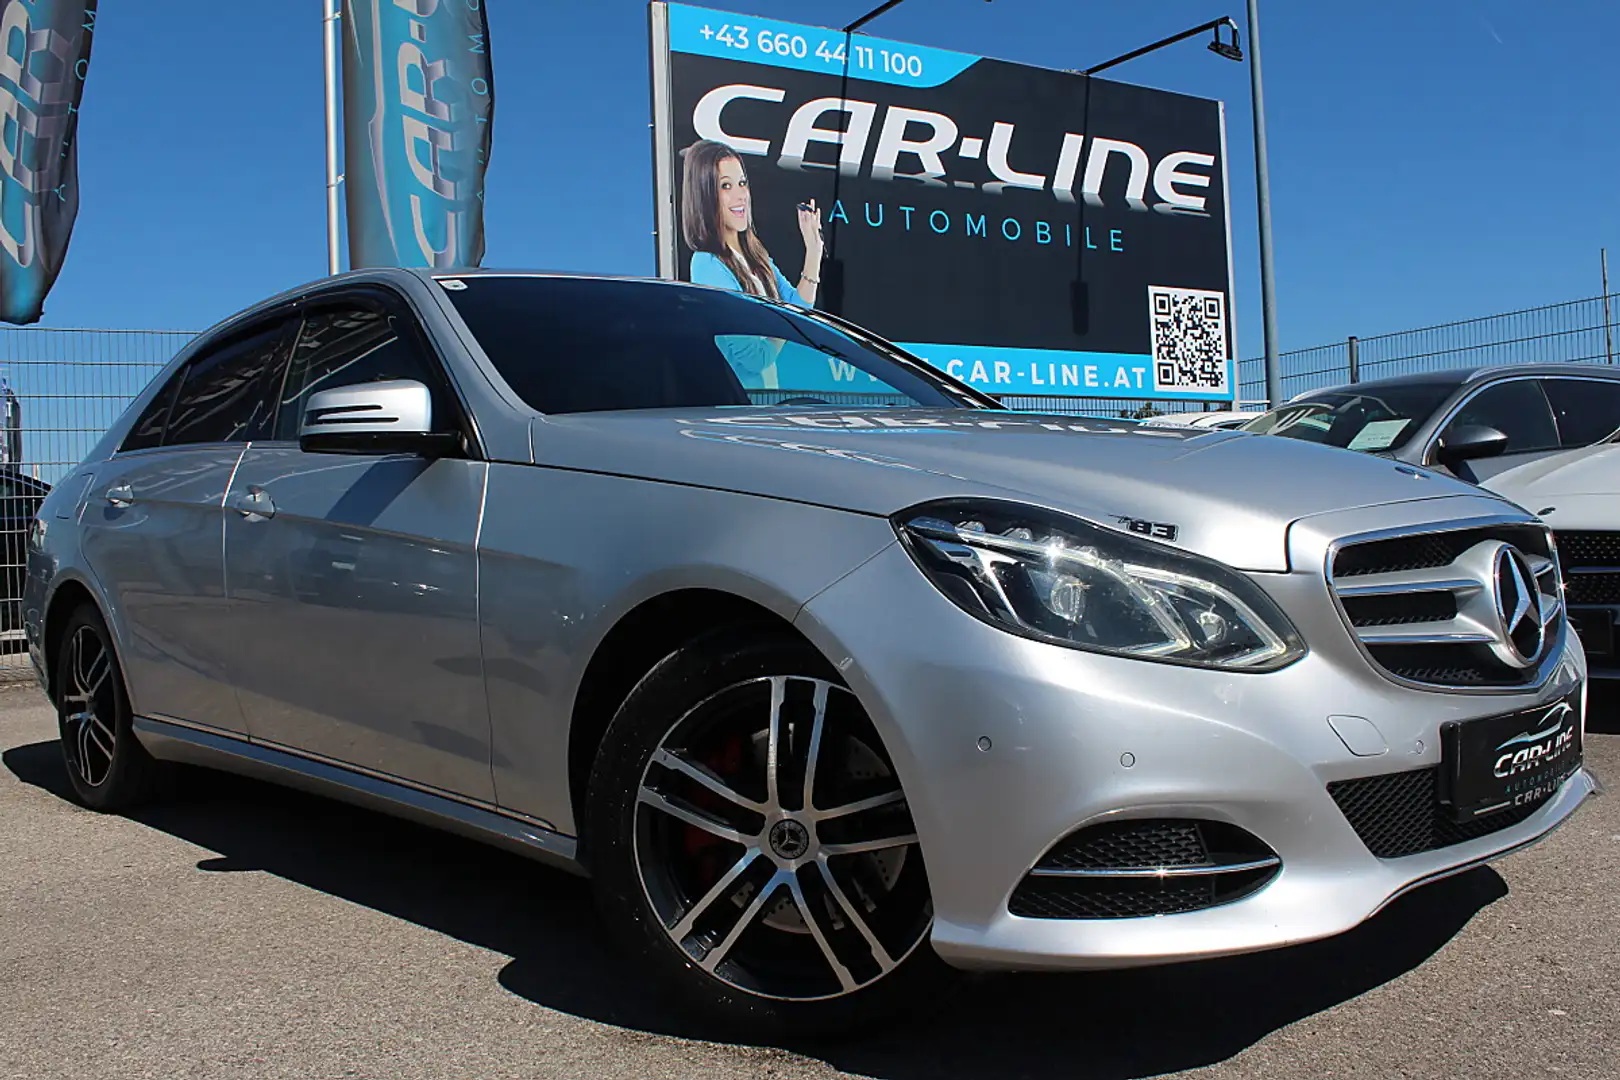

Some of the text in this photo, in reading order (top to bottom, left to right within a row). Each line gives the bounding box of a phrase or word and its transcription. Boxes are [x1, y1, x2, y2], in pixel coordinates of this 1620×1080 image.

[699, 24, 923, 77] +43 660 44 11 100
[0, 0, 50, 268] CAR
[692, 82, 1215, 208] CAR-LINE
[828, 200, 1124, 252] AUTOMOBILE
